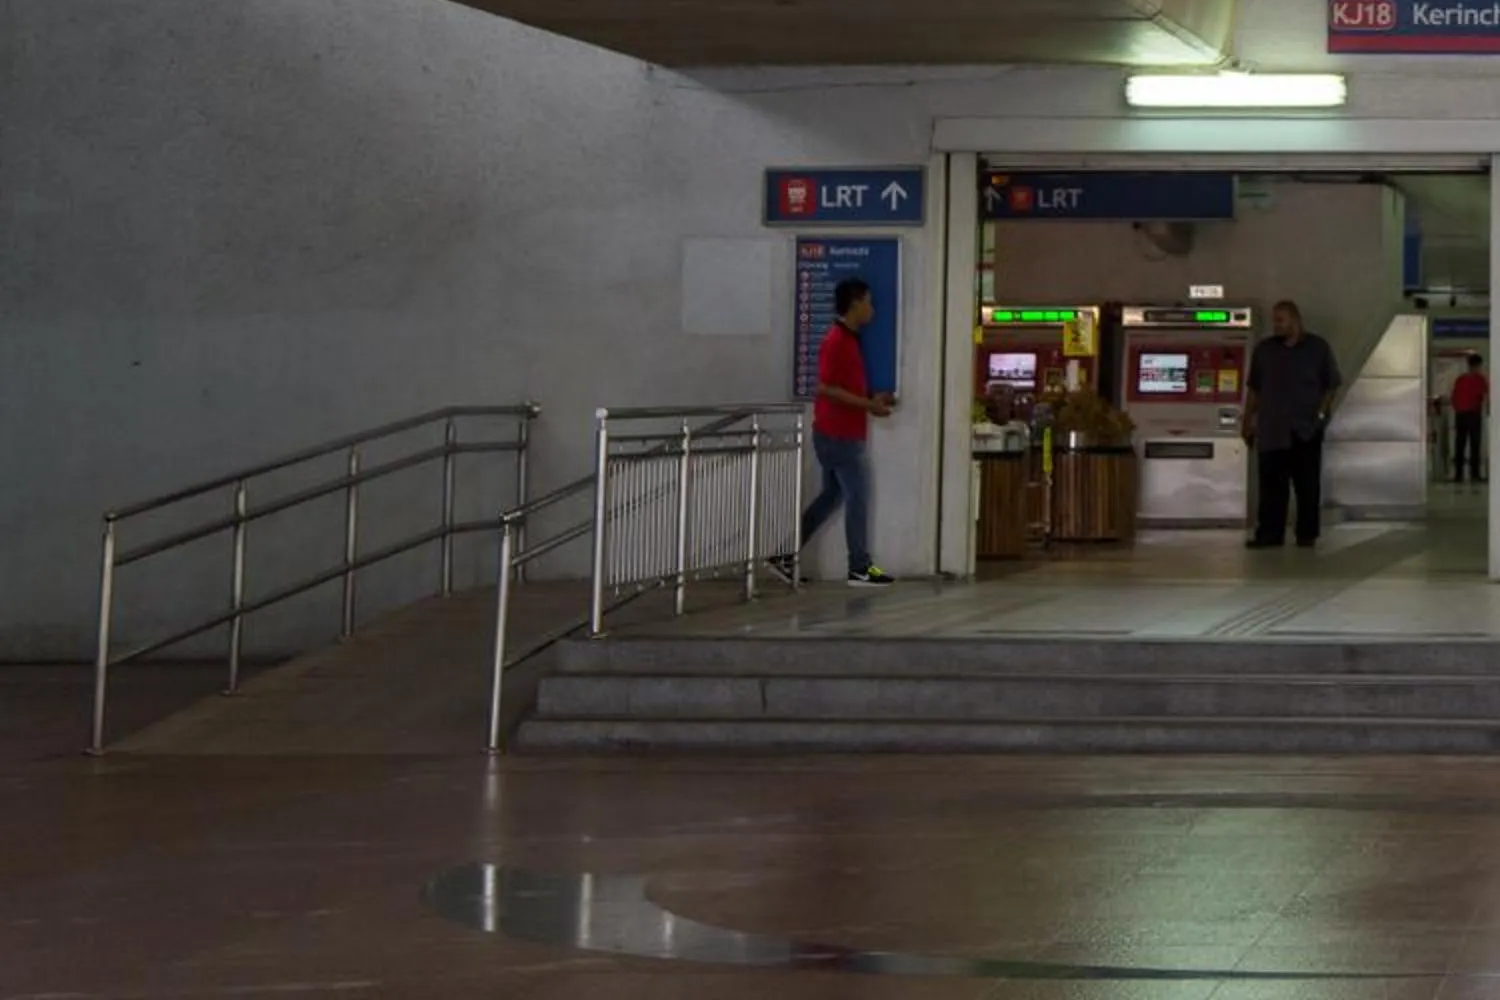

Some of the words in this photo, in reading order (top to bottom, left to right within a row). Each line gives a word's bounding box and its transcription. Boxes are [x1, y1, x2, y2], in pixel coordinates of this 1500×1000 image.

[1332, 2, 1392, 25] KJ18
[820, 185, 869, 208] LRT
[1037, 188, 1083, 208] LRT
